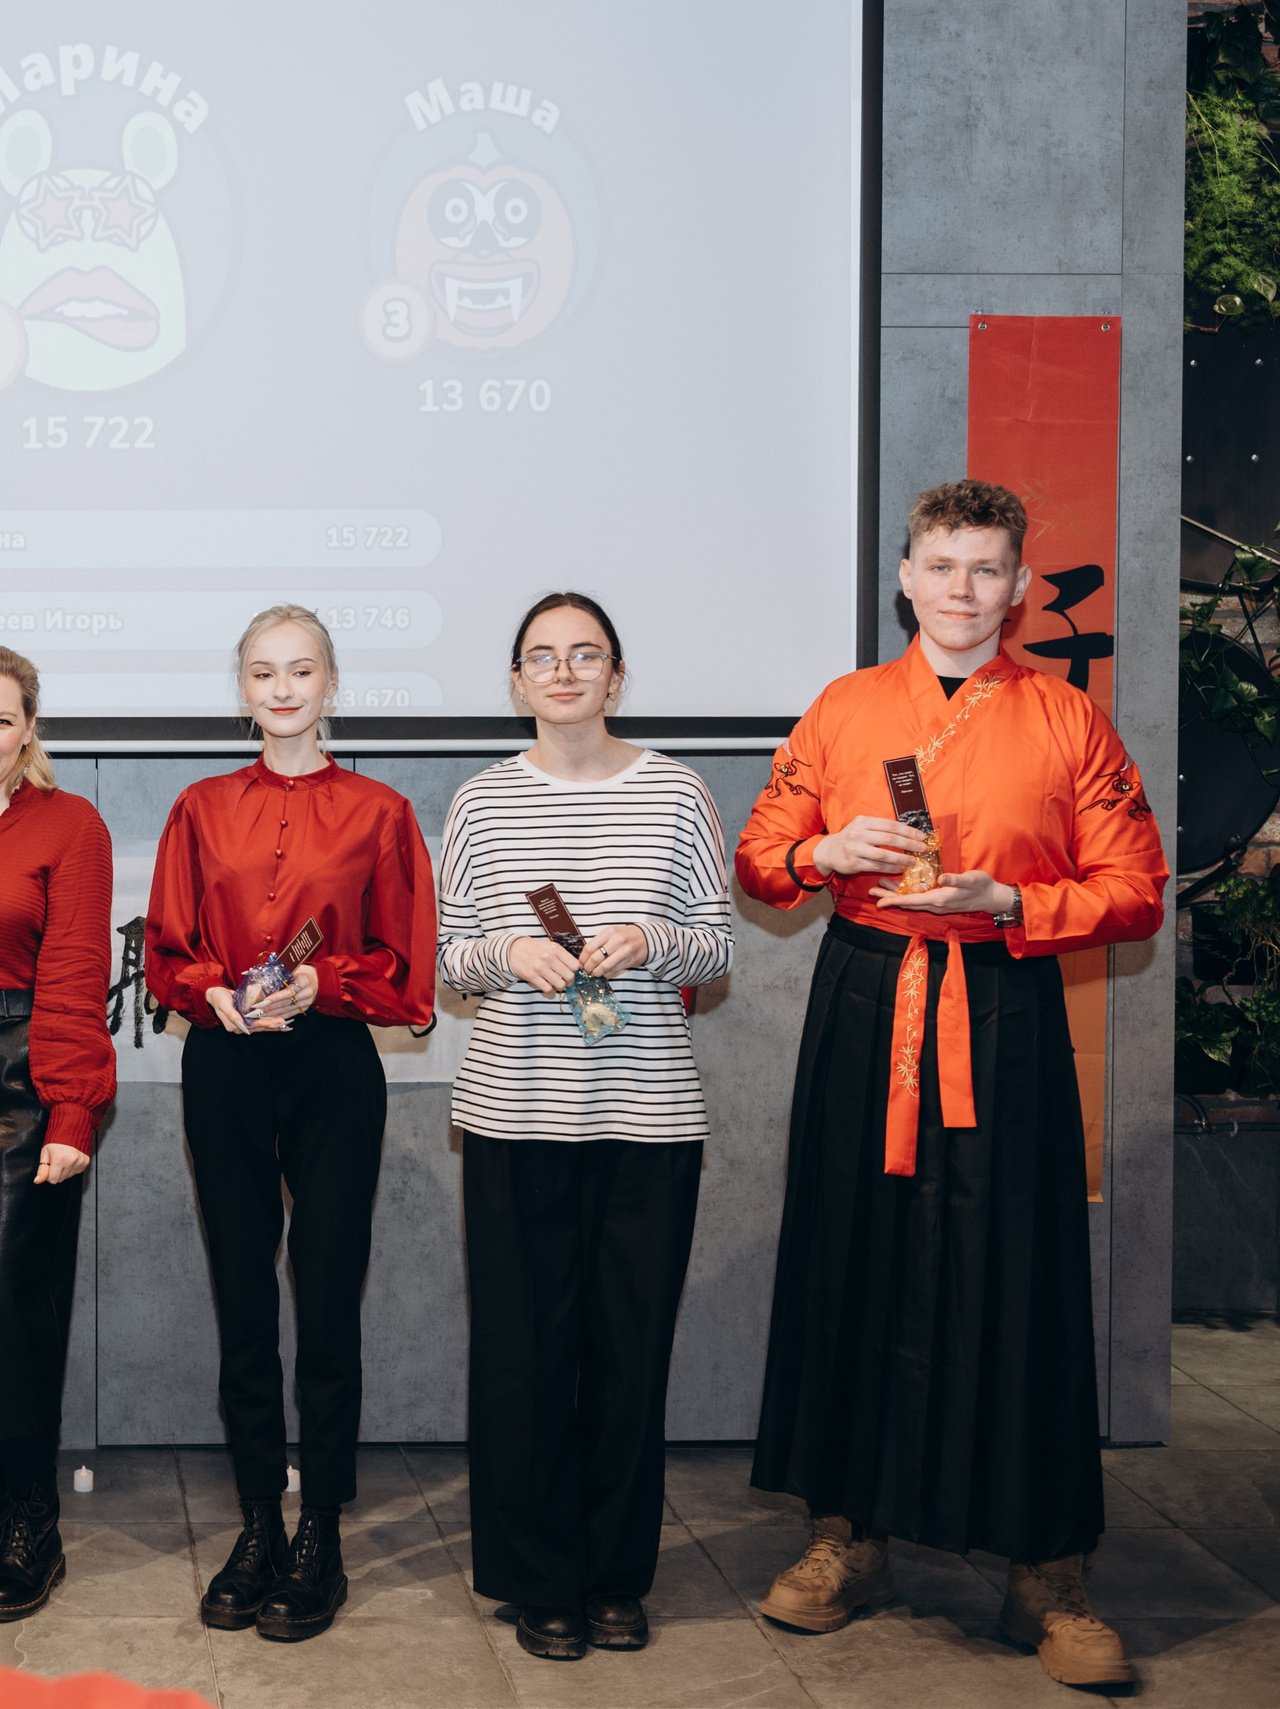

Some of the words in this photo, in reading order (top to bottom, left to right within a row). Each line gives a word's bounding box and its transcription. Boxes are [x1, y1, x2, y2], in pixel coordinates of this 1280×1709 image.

[404, 77, 561, 134] Маша
[384, 300, 411, 338] 3
[418, 379, 464, 413] 13
[479, 379, 552, 413] 670
[22, 415, 69, 450] 15
[82, 415, 156, 450] 722
[326, 526, 356, 548] 15
[364, 526, 410, 548] 722
[44, 609, 123, 637] Игорь
[328, 608, 357, 629] 13
[365, 608, 410, 630] 746
[365, 689, 410, 707] 670
